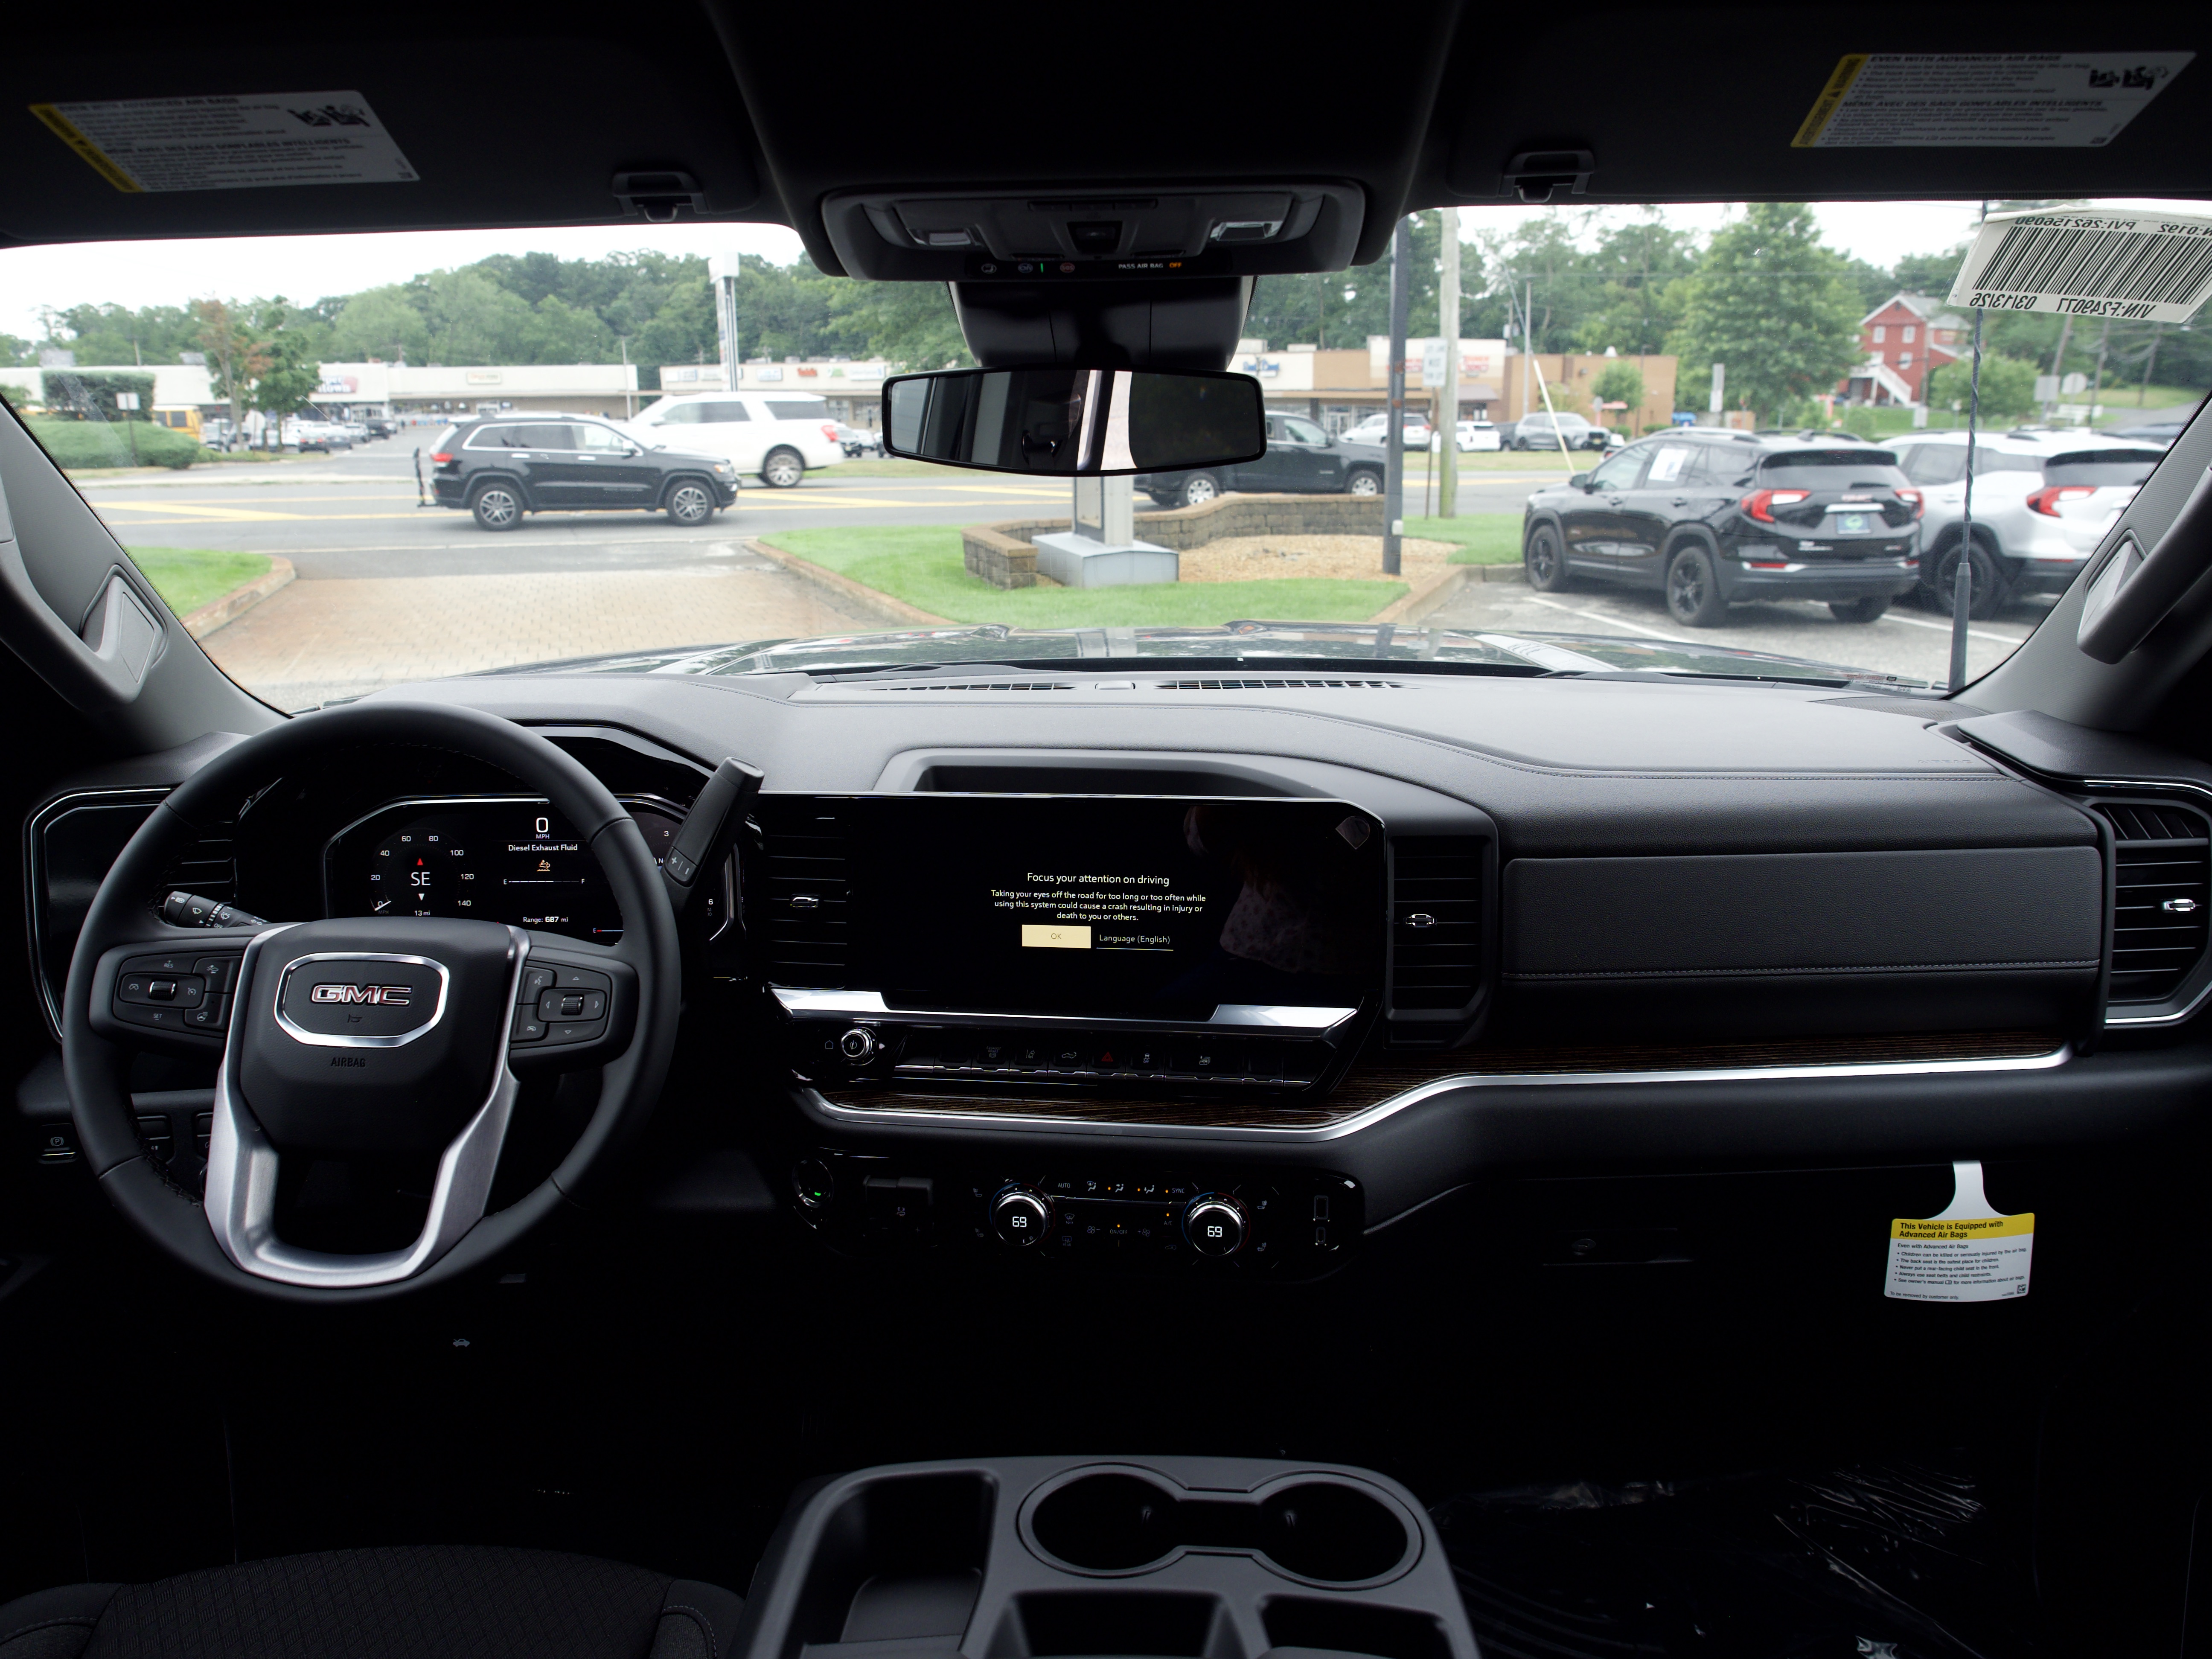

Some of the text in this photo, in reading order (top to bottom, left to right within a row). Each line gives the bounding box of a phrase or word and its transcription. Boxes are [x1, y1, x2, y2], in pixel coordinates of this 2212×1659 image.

[535, 817, 549, 833] 0
[410, 871, 431, 886] SE
[1027, 873, 1054, 882] Focus
[1056, 876, 1077, 885] your
[1079, 874, 1121, 883] attention
[1137, 874, 1170, 887] driving
[991, 889, 1014, 899] Taking
[1123, 893, 1139, 901] long
[994, 901, 1014, 909] using
[1030, 902, 1056, 910] system
[1129, 903, 1161, 913] resulting
[1172, 905, 1193, 914] injury
[523, 916, 544, 924] Range:
[1057, 911, 1078, 920] death
[1099, 934, 1170, 945] Language (English)
[311, 985, 413, 1005] GMC
[331, 1057, 366, 1067] AIRBAG
[1012, 1217, 1027, 1228] 69
[1955, 1222, 1987, 1230] Equipped
[1207, 1226, 1222, 1237] 69
